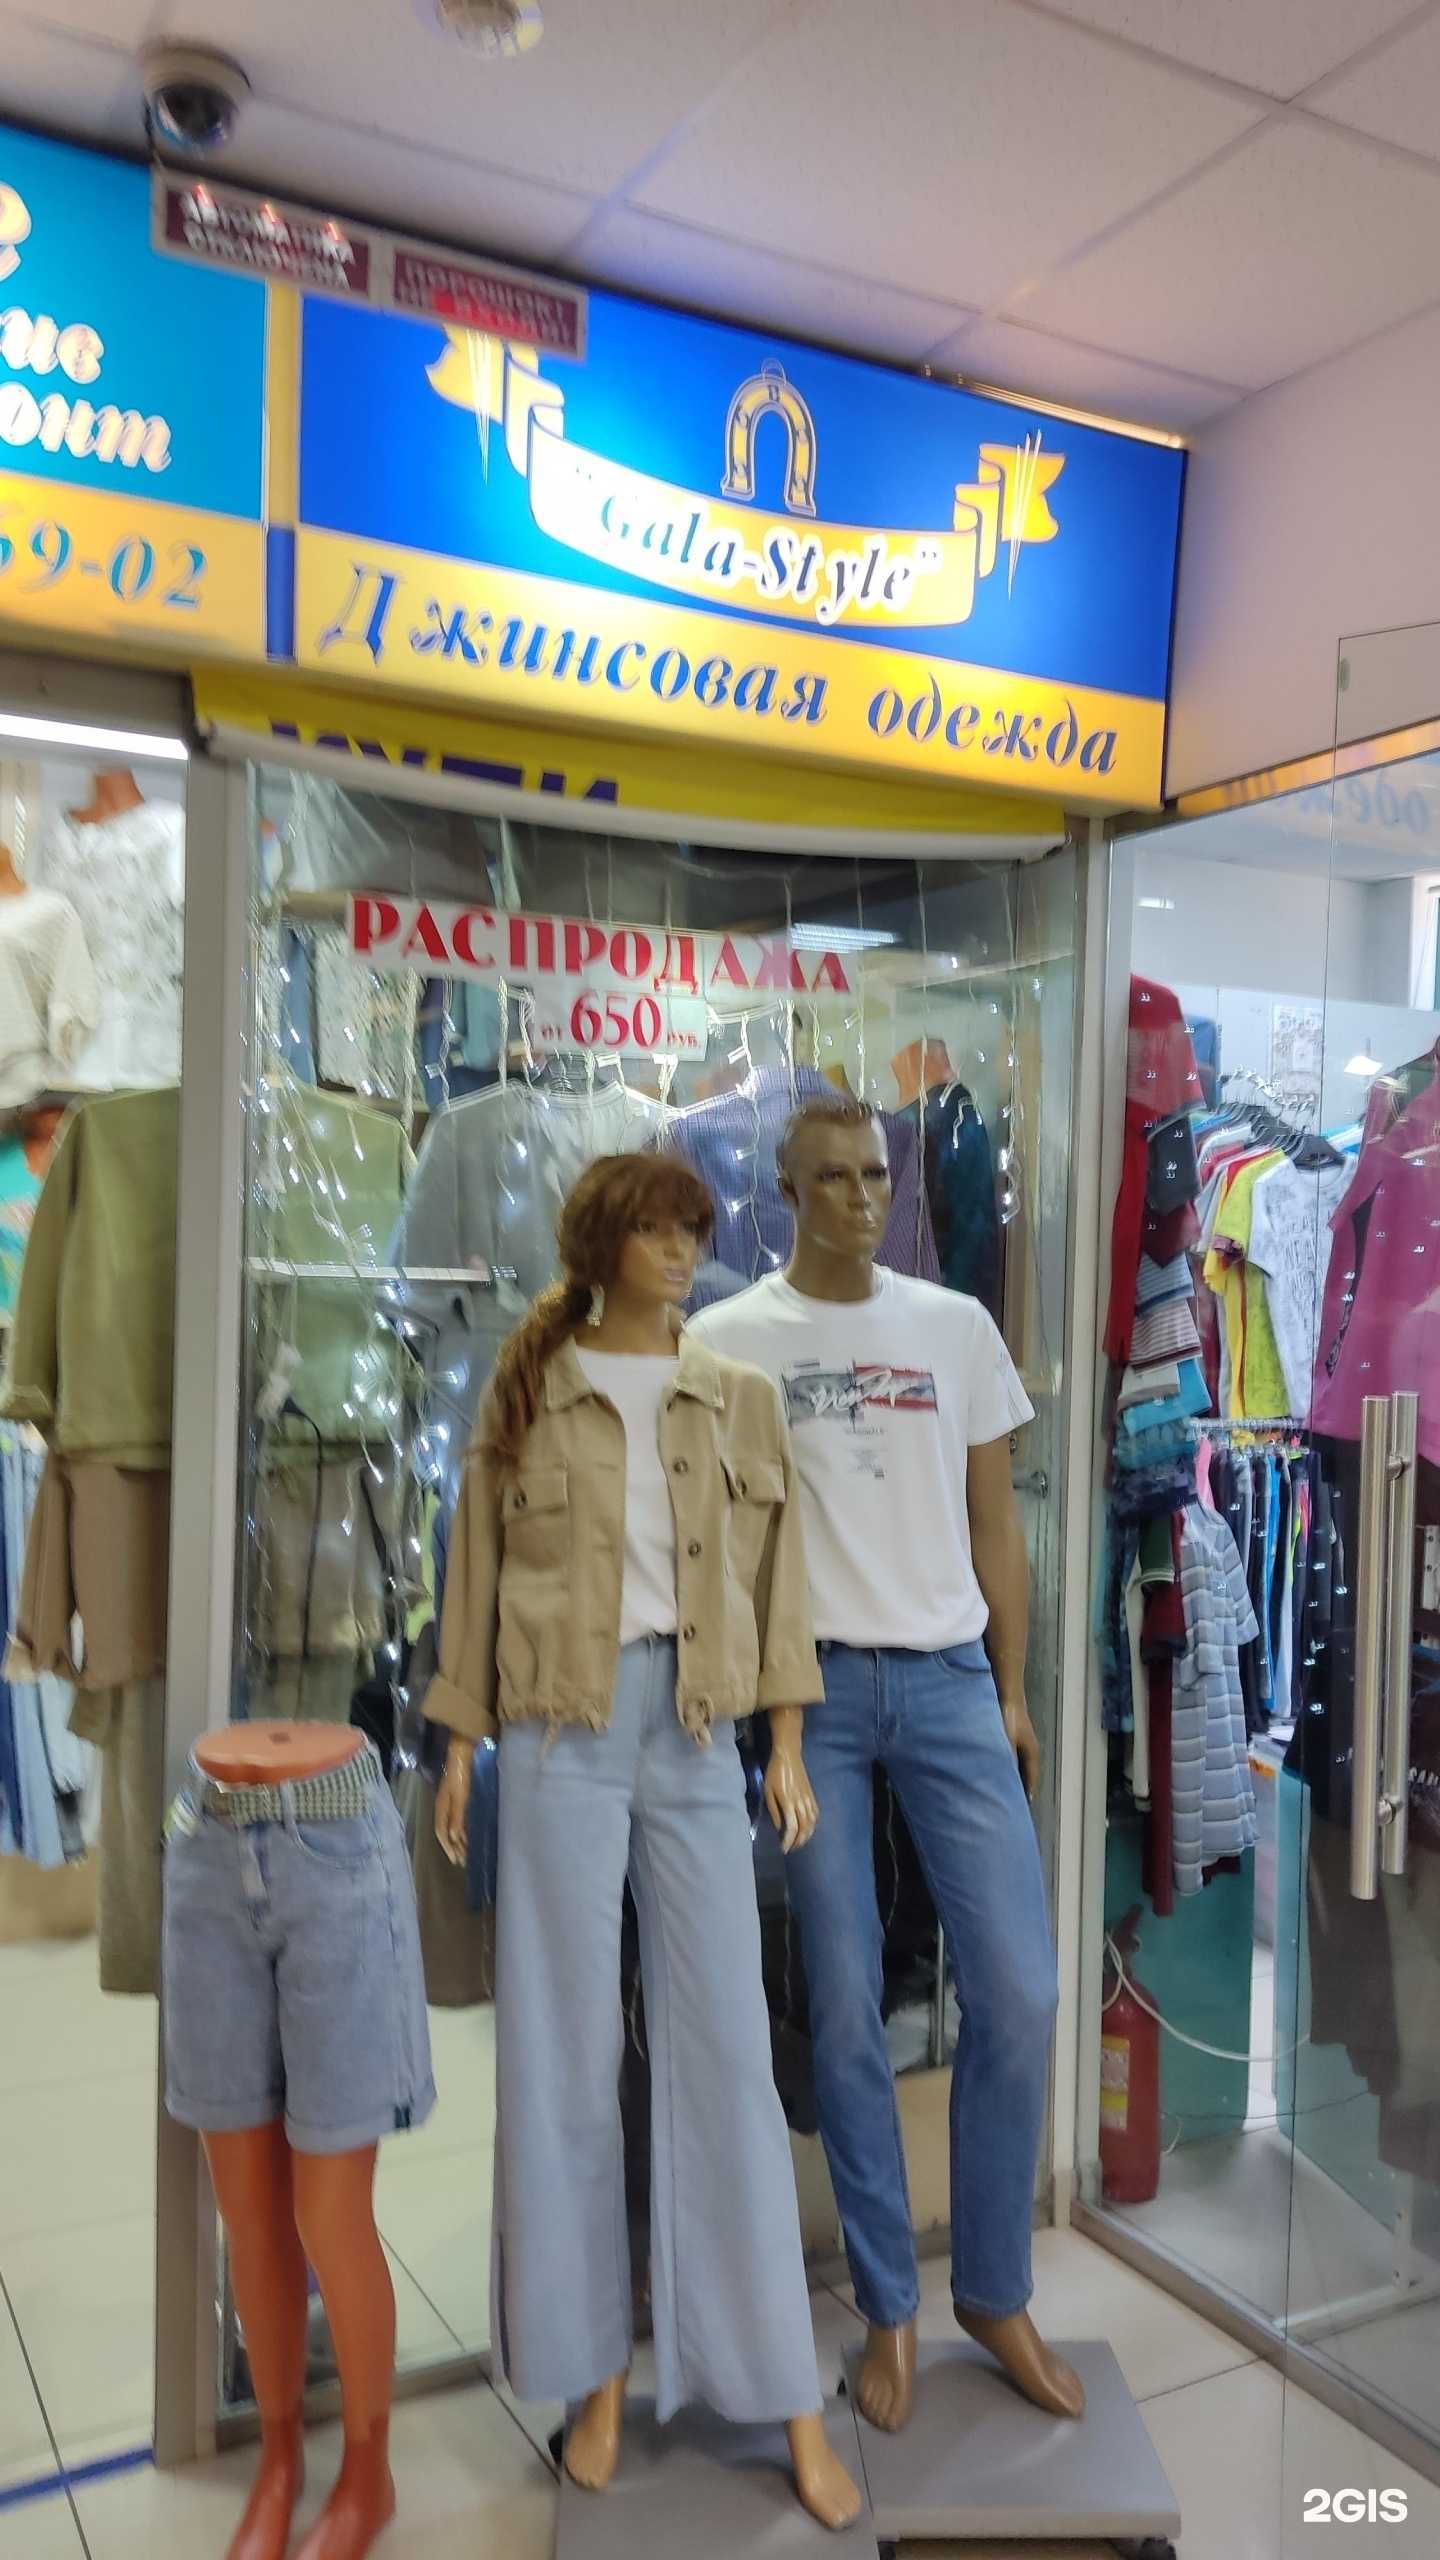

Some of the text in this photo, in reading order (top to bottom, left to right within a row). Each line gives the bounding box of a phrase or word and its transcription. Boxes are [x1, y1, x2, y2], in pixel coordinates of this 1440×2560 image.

[316, 564, 1118, 774] Джинсовая одежда
[352, 898, 852, 995] РАСПРОДАЖА
[570, 989, 662, 1048] 650
